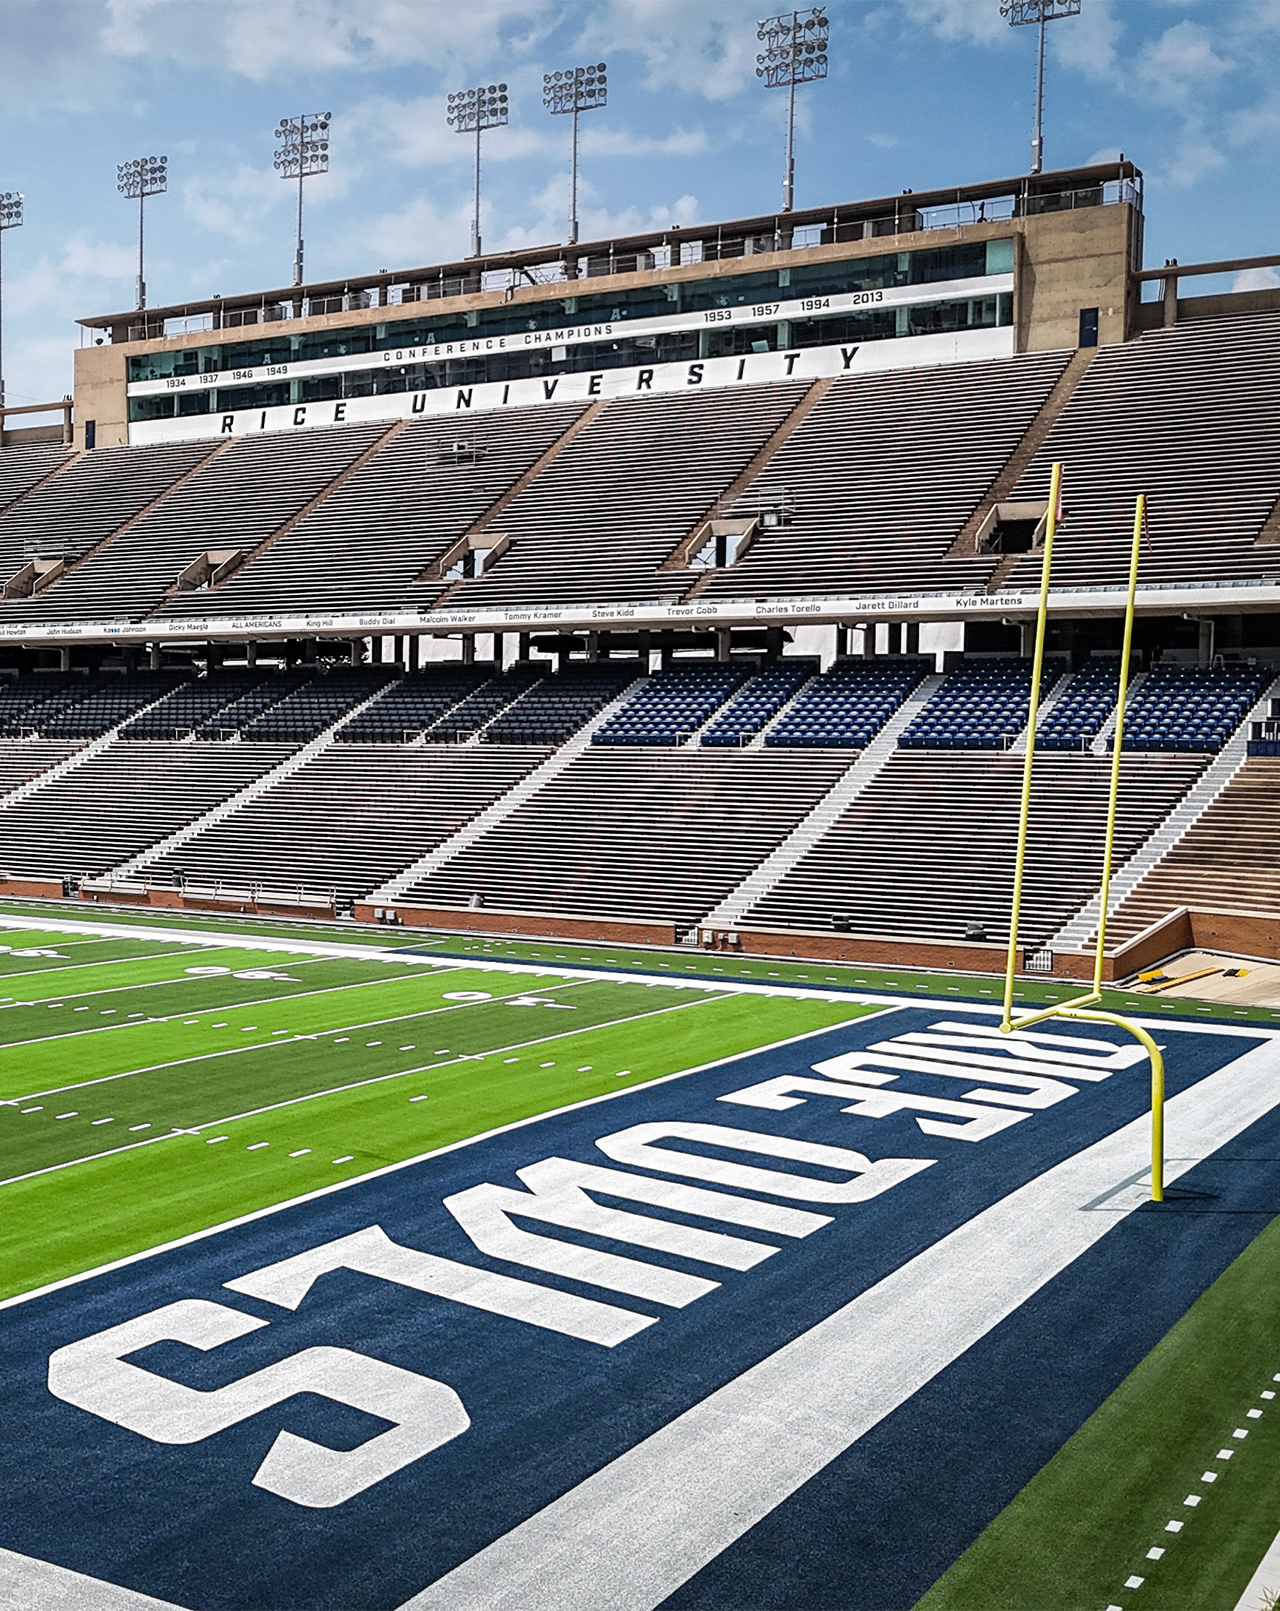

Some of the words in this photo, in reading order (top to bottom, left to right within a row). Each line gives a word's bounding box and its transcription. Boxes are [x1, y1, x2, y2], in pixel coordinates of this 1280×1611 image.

[704, 310, 732, 322] 1953
[752, 304, 780, 317] 1957
[801, 298, 830, 311] 1994
[852, 291, 884, 305] 2013
[383, 338, 506, 362] CONFERENCE
[524, 324, 613, 345] CHAMPIONS
[166, 378, 186, 388] 1934
[199, 374, 219, 384] 1937
[232, 369, 253, 380] 1946
[266, 365, 288, 376] 1949
[221, 402, 347, 433] RICE
[411, 346, 860, 414] UNIVERSITY
[855, 601, 885, 610] Jarett
[888, 600, 919, 609] Dillard
[956, 598, 977, 608] Kyle
[980, 596, 1023, 606] Martens
[592, 610, 615, 618] Steve
[616, 609, 634, 617] Kidd
[667, 608, 694, 616] Trevor
[756, 605, 788, 614] Charles
[791, 604, 821, 613] Torello
[419, 616, 448, 624] Malcolm
[504, 612, 531, 621] Tommy
[534, 611, 562, 619] Kramer
[231, 621, 243, 629] ALL
[244, 620, 282, 628] AMERICANS
[306, 620, 321, 628] King
[359, 618, 381, 626] Buddy
[382, 617, 395, 625] Dial
[717, 1020, 1167, 1143] RICE
[47, 1120, 938, 1509] OWLS
